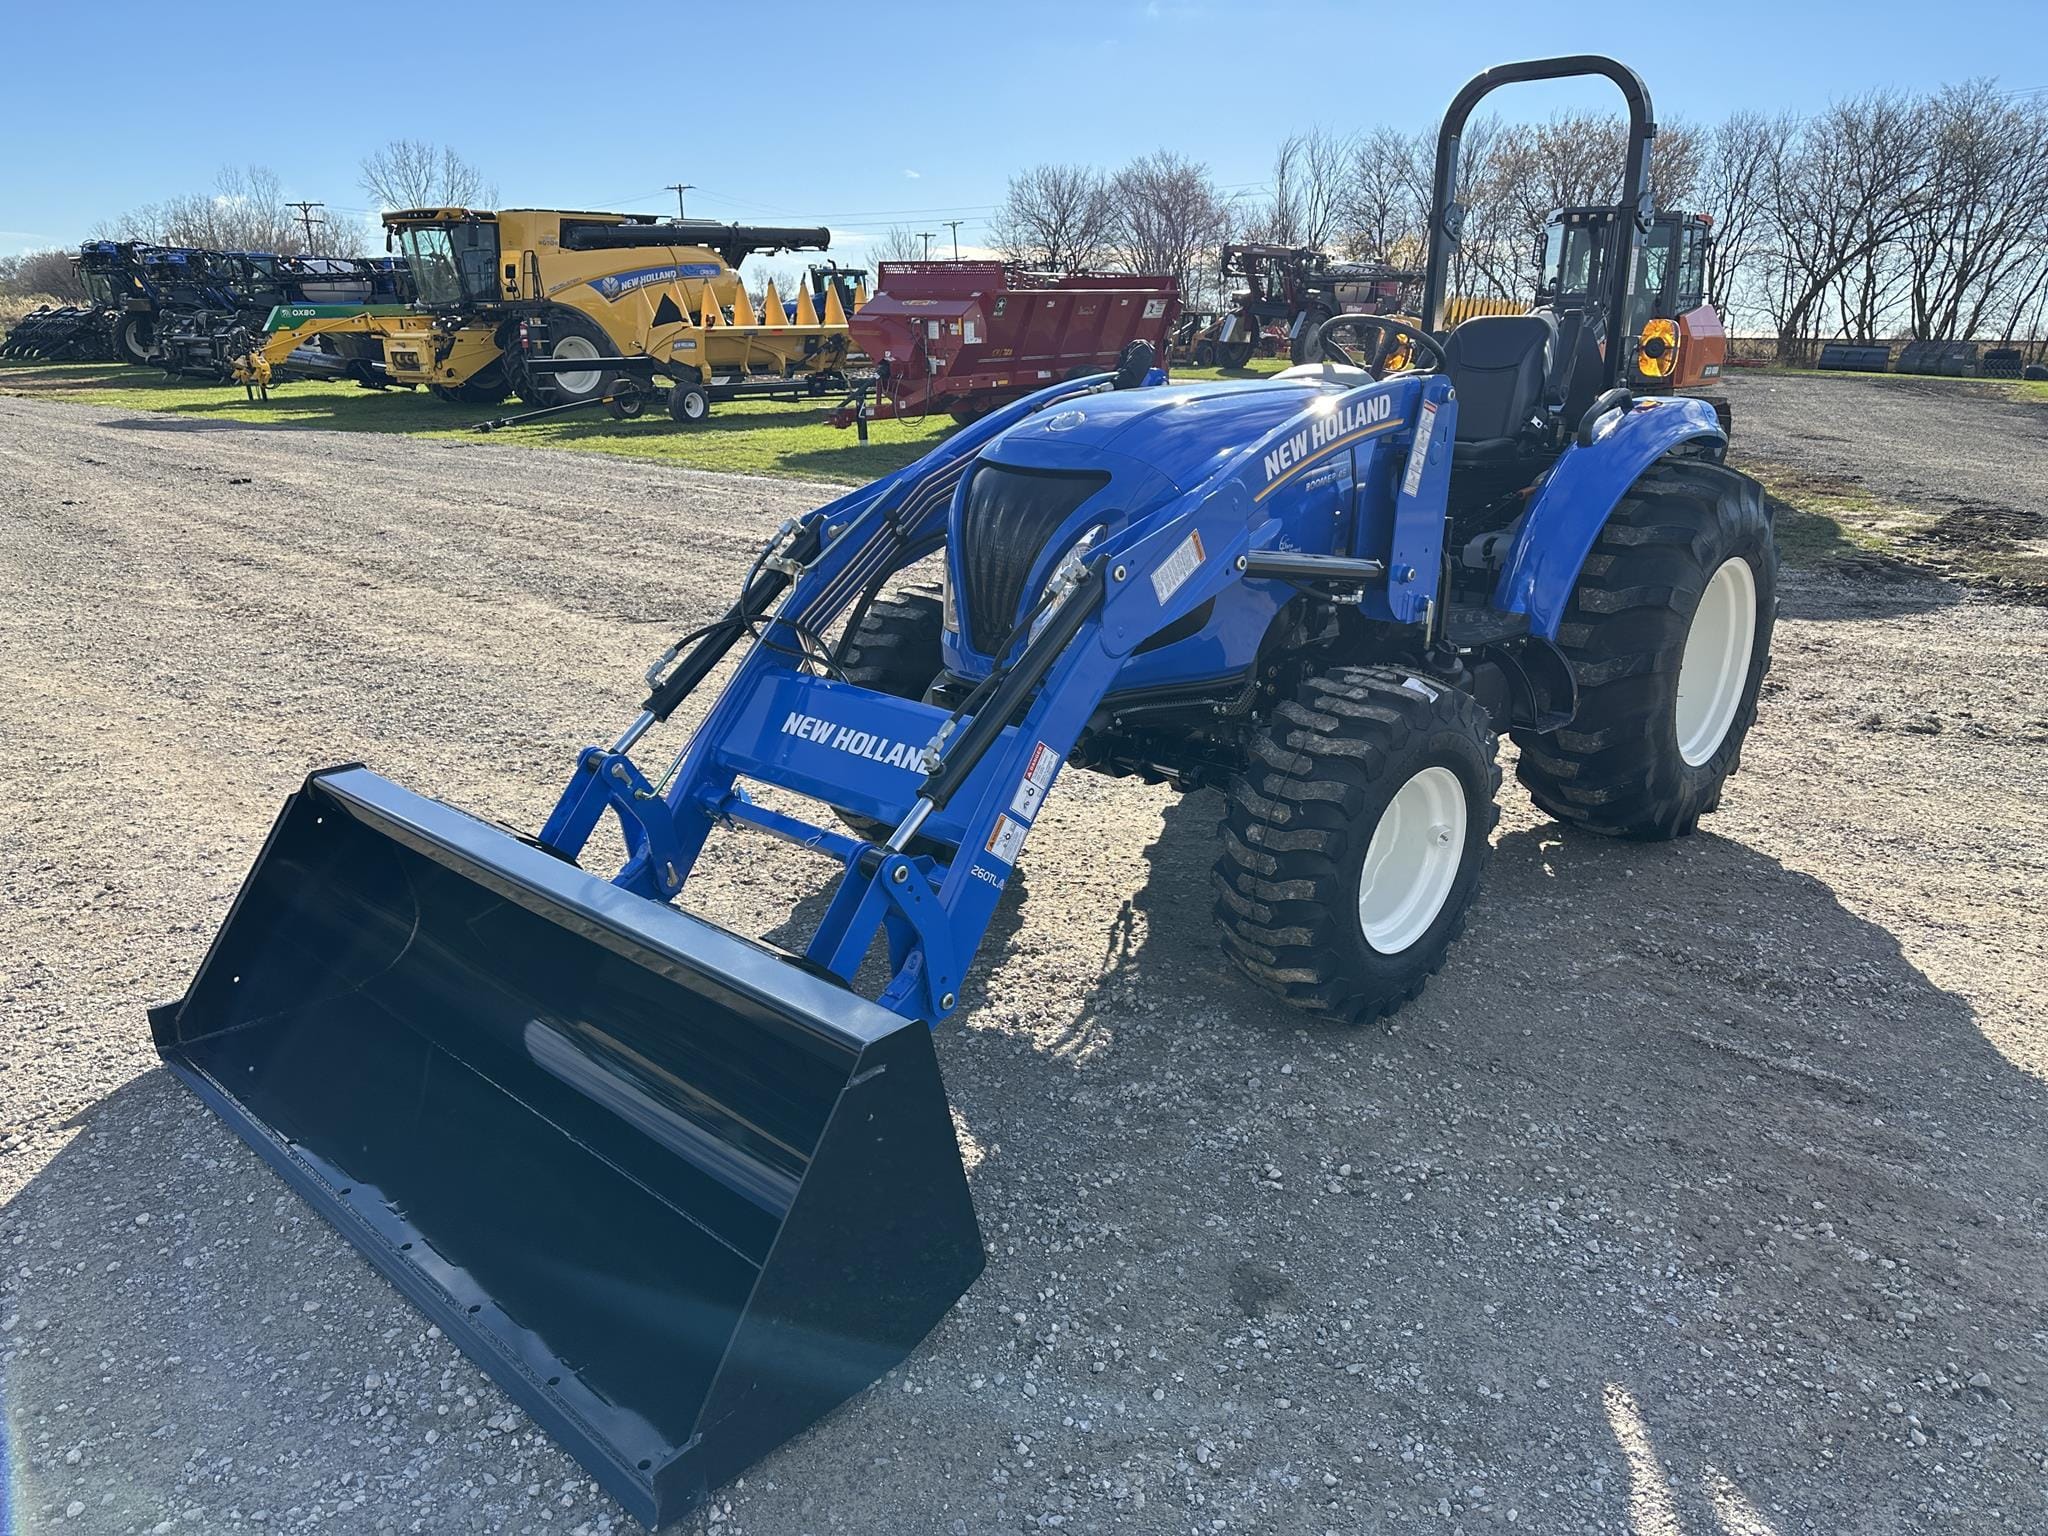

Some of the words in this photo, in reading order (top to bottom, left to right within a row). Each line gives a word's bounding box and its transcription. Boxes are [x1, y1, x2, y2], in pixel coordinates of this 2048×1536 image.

[621, 277, 639, 291] NEW
[640, 270, 677, 286] HOLLAND
[1264, 429, 1308, 481] NEW
[1311, 394, 1391, 450] HOLLAND
[781, 712, 837, 745] NEW
[971, 864, 1005, 891] 260TLA
